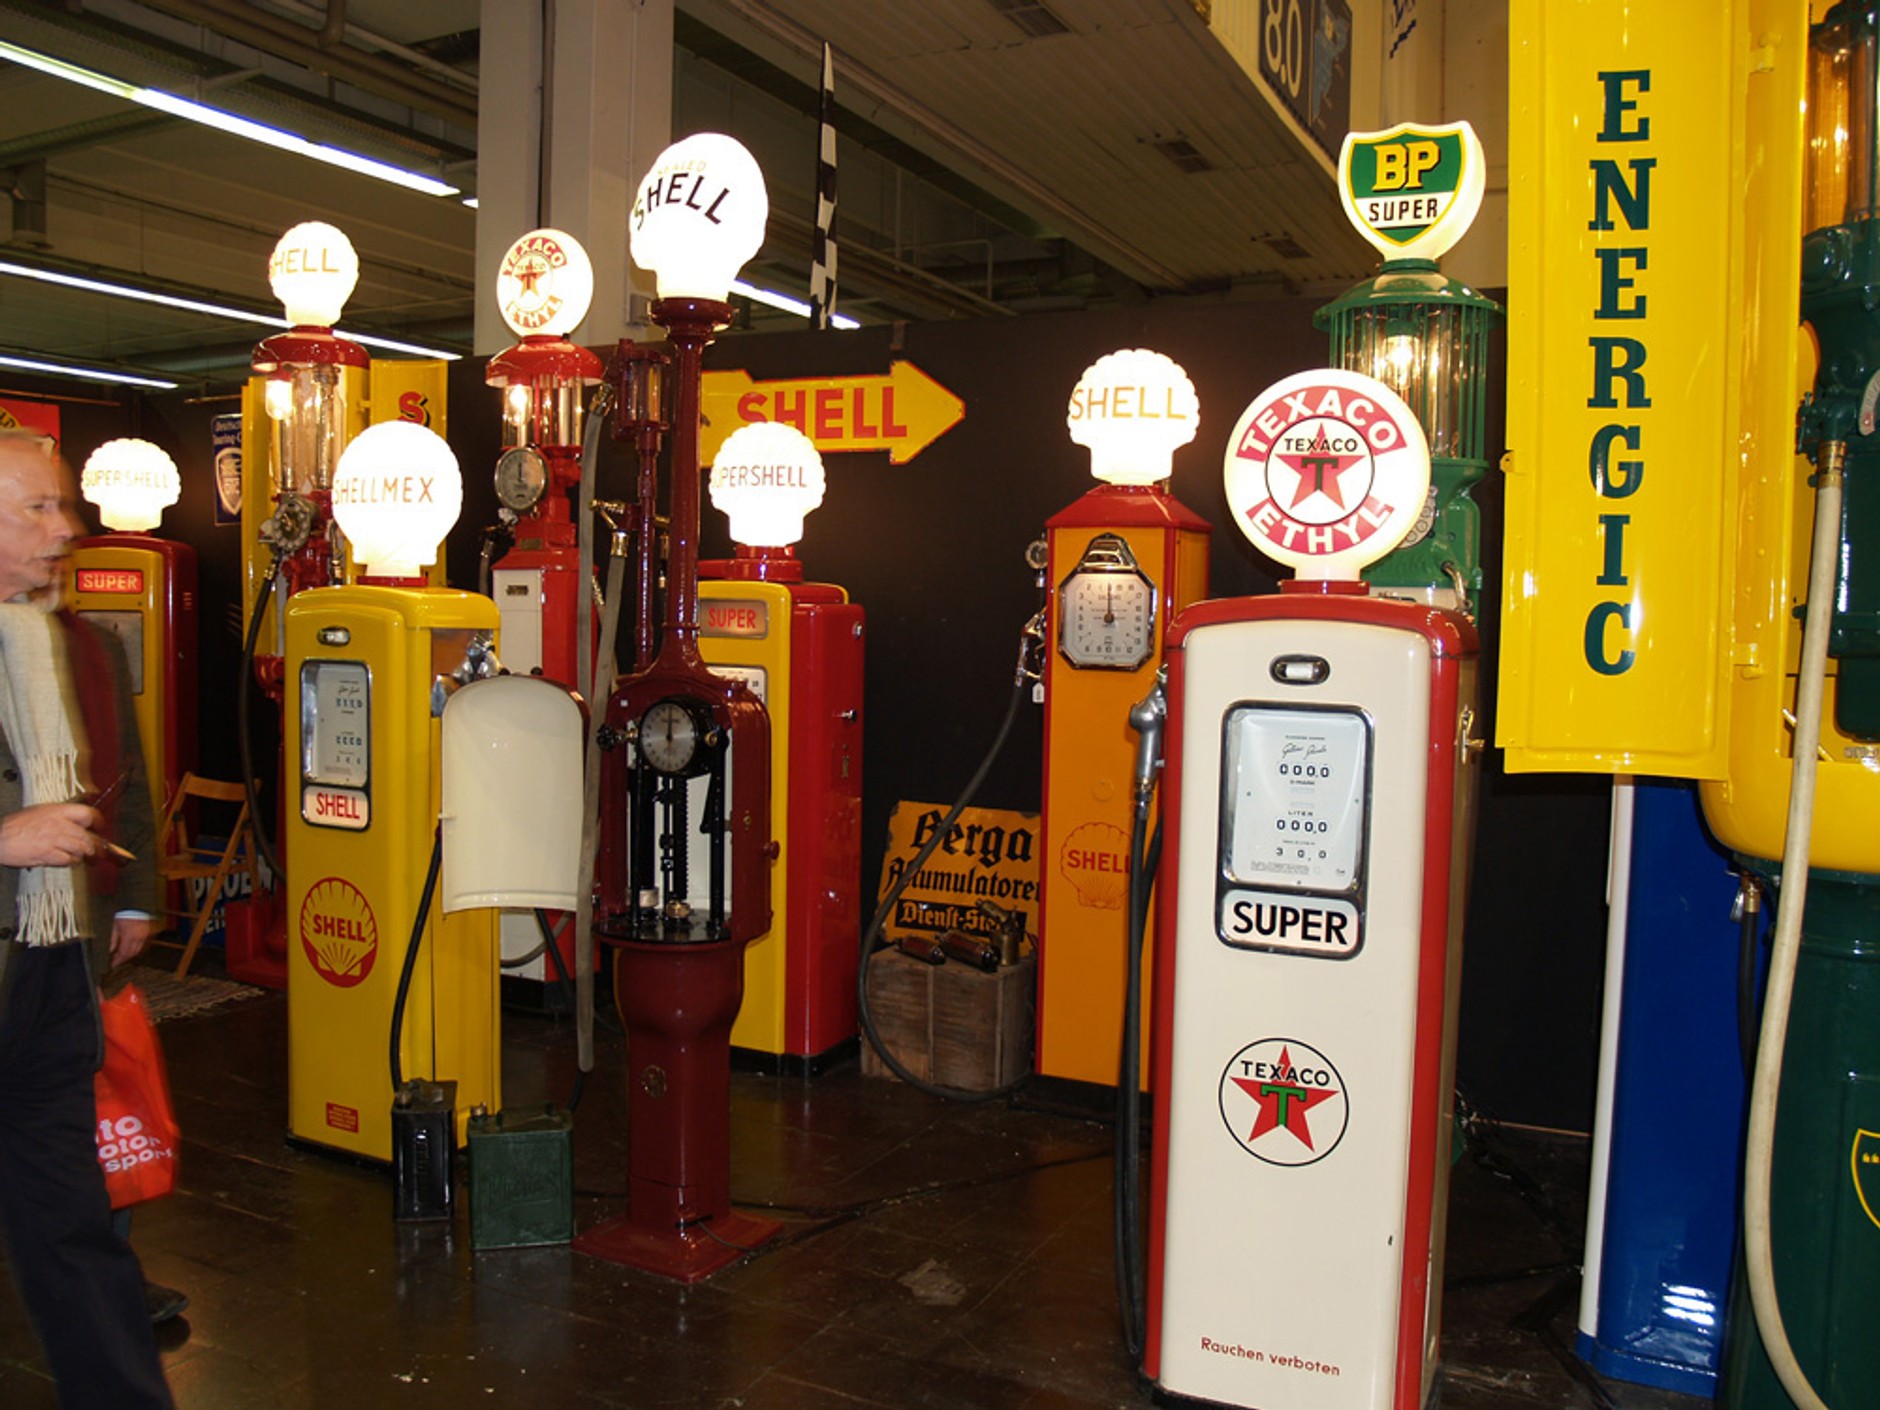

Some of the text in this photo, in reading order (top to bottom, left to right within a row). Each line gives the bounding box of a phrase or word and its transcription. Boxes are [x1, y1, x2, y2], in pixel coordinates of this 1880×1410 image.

[1371, 141, 1441, 192] BP
[634, 172, 730, 231] SHELL
[1369, 198, 1438, 222] SUPER
[271, 247, 340, 275] HELL
[503, 239, 565, 274] TEXACO
[1584, 70, 1657, 675] ENERGIC
[737, 386, 907, 439] SHELL
[1071, 386, 1187, 421] SHELL
[1240, 389, 1398, 455] TEXACO
[1284, 437, 1359, 453] TEXACO
[712, 465, 808, 488] PERSHELL
[1251, 502, 1393, 553] ETHYL
[83, 573, 138, 590] SUPER
[708, 607, 757, 629] SUPER
[316, 792, 361, 820] SHELL
[910, 810, 1034, 868] Berga
[313, 913, 367, 943] SHELL
[1233, 900, 1348, 946] SUPER
[1241, 1060, 1330, 1087] TEXACO
[95, 1115, 143, 1142] to
[98, 1135, 162, 1160] otor
[1201, 1337, 1341, 1377] Rauchen verboten
